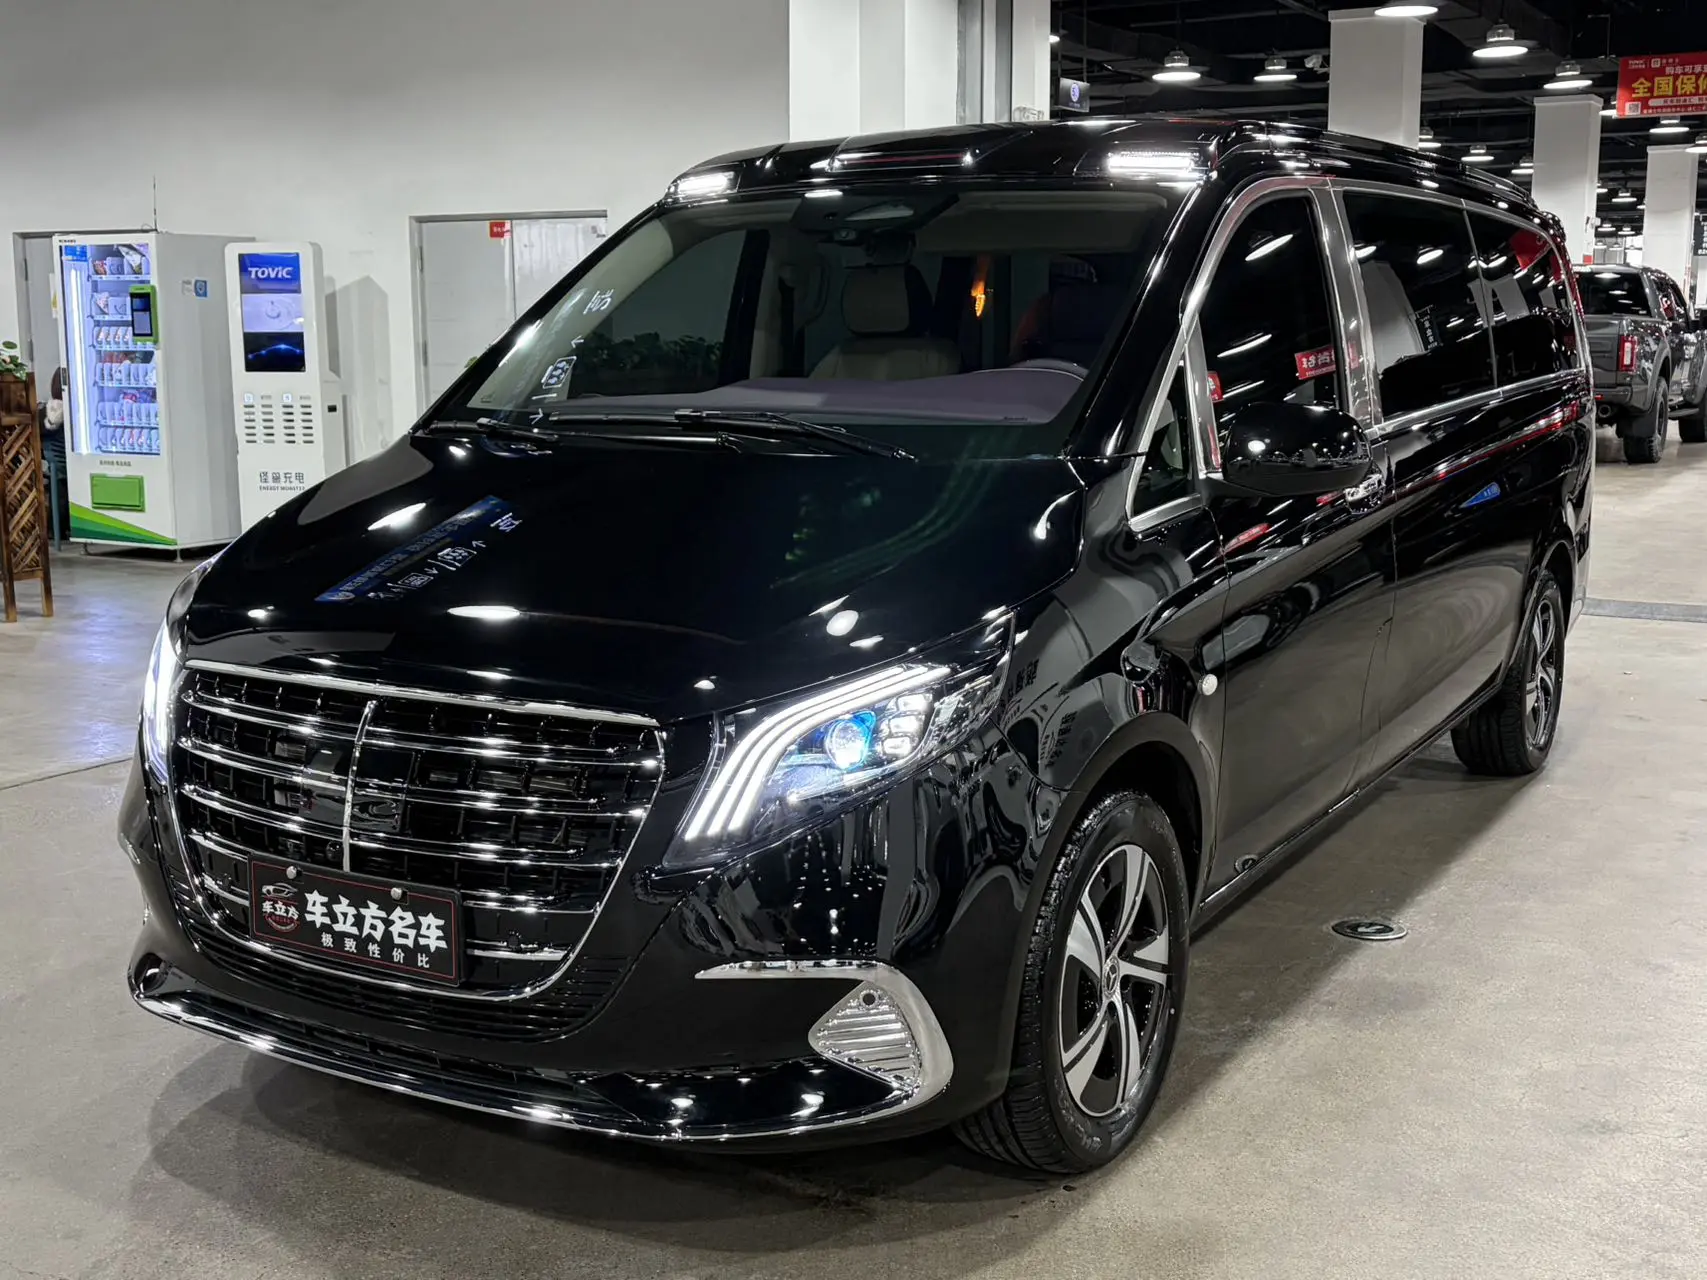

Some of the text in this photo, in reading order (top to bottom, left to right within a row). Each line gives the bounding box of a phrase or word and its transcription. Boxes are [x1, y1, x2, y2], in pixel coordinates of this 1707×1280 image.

[247, 266, 294, 279] TOVIC
[259, 471, 304, 483] 怪兽充电
[262, 900, 300, 920] 车立方
[304, 889, 448, 952] 车立方名车
[321, 931, 430, 968] 极致性价比
